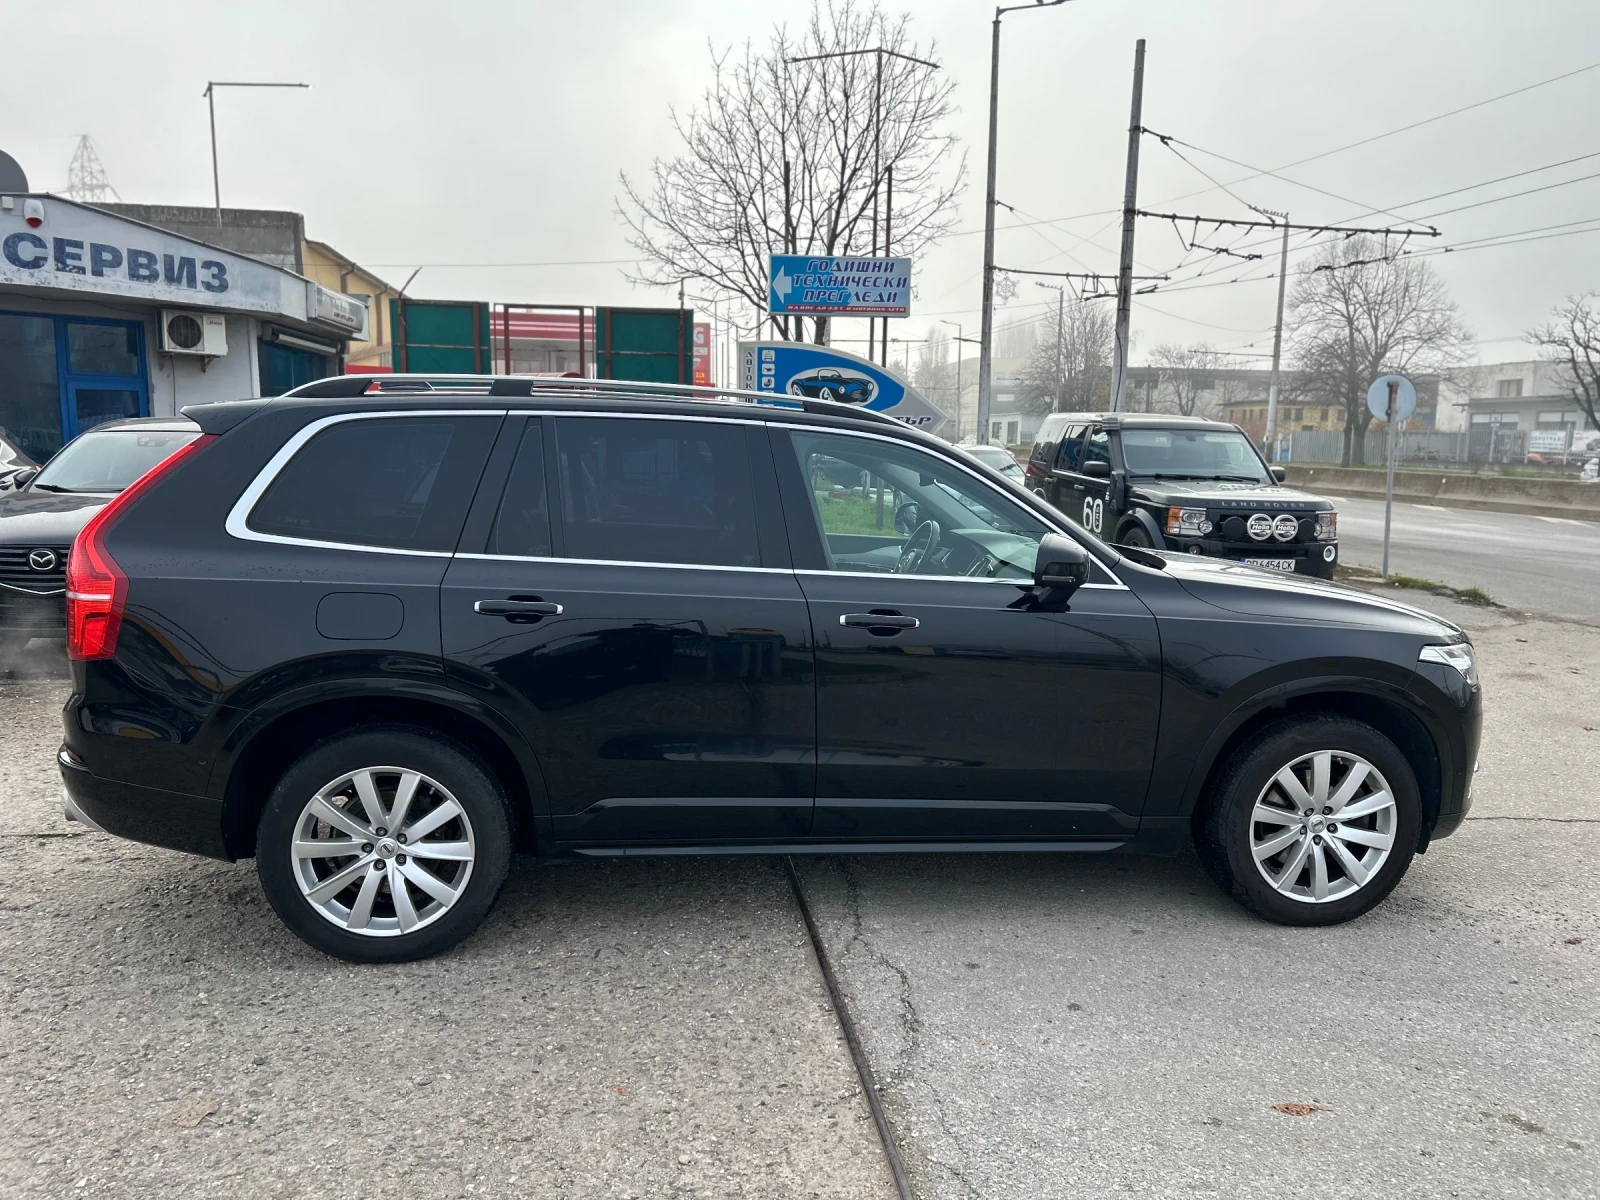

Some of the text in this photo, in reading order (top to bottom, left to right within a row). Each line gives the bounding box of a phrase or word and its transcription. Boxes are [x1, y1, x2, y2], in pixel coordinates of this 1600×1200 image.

[3, 232, 230, 293] СЕРВИЗ
[806, 259, 895, 273] ГОДИШНИ
[793, 274, 908, 288] ТЕХНИЧЕСКИ
[802, 289, 898, 303] ПРЕГЛЕДИ
[1083, 496, 1103, 533] 60
